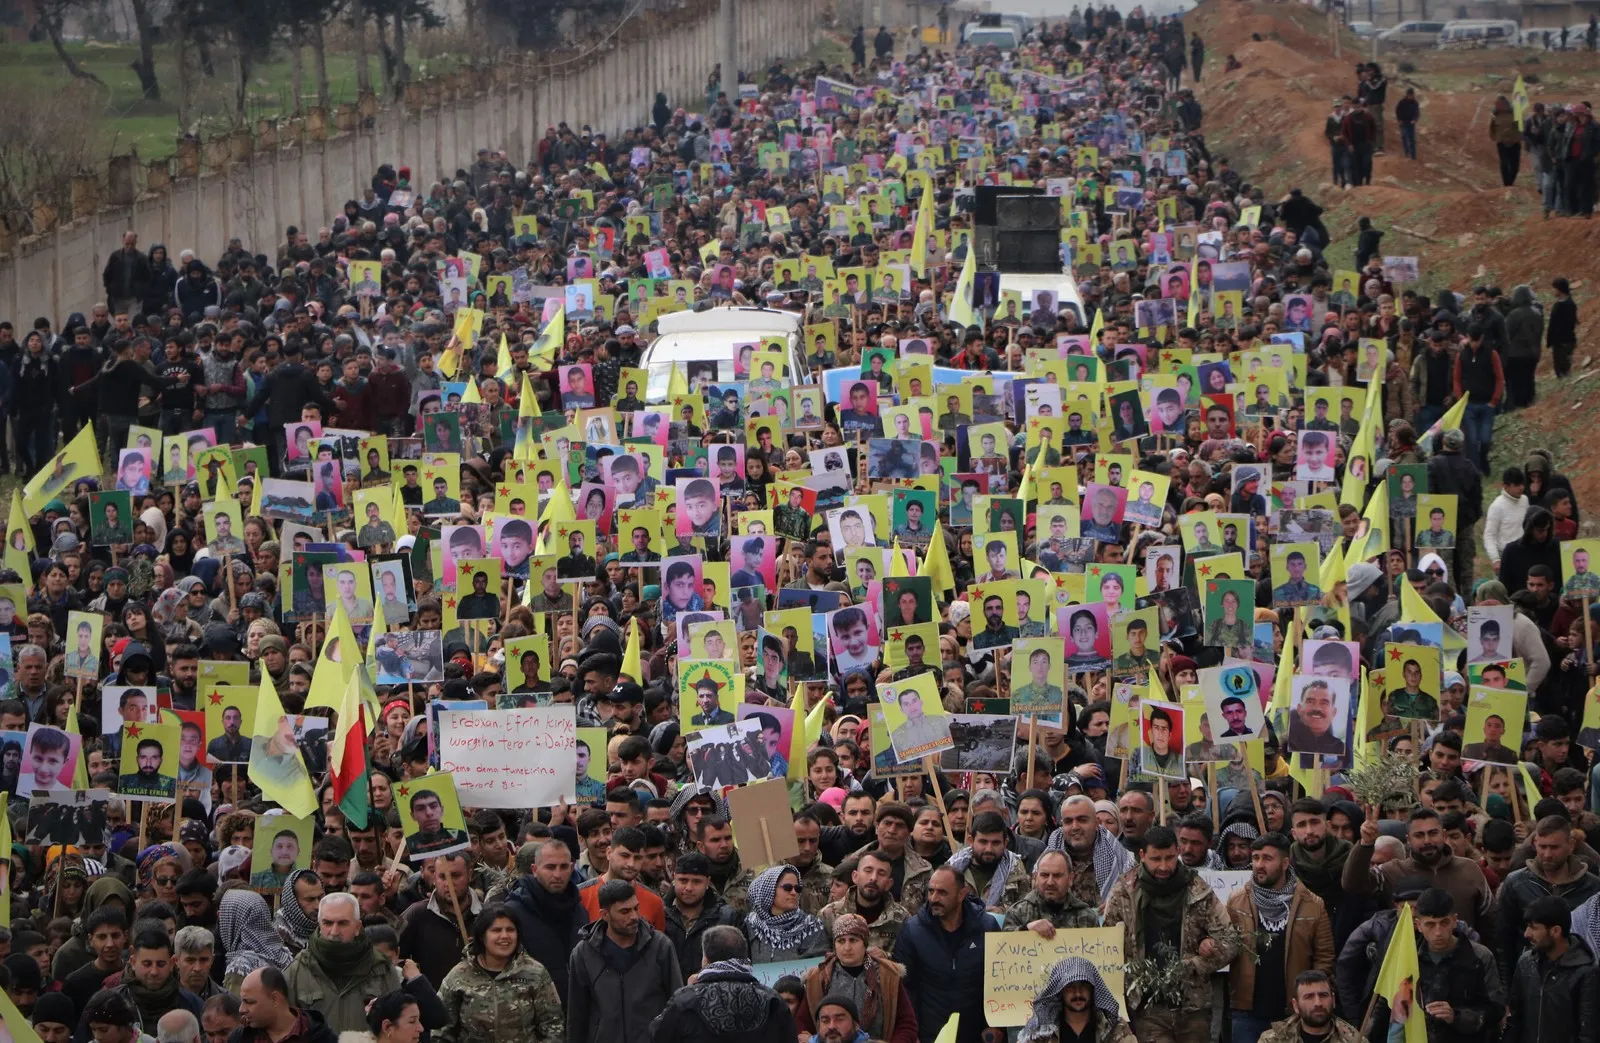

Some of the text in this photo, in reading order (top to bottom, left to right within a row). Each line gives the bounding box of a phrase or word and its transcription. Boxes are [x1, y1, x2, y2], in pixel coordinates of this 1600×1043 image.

[498, 733, 530, 750] teror
[443, 761, 471, 773] Dema
[476, 763, 498, 773] dema
[1054, 937, 1119, 957] derketina
[986, 999, 1016, 1013] Dem
